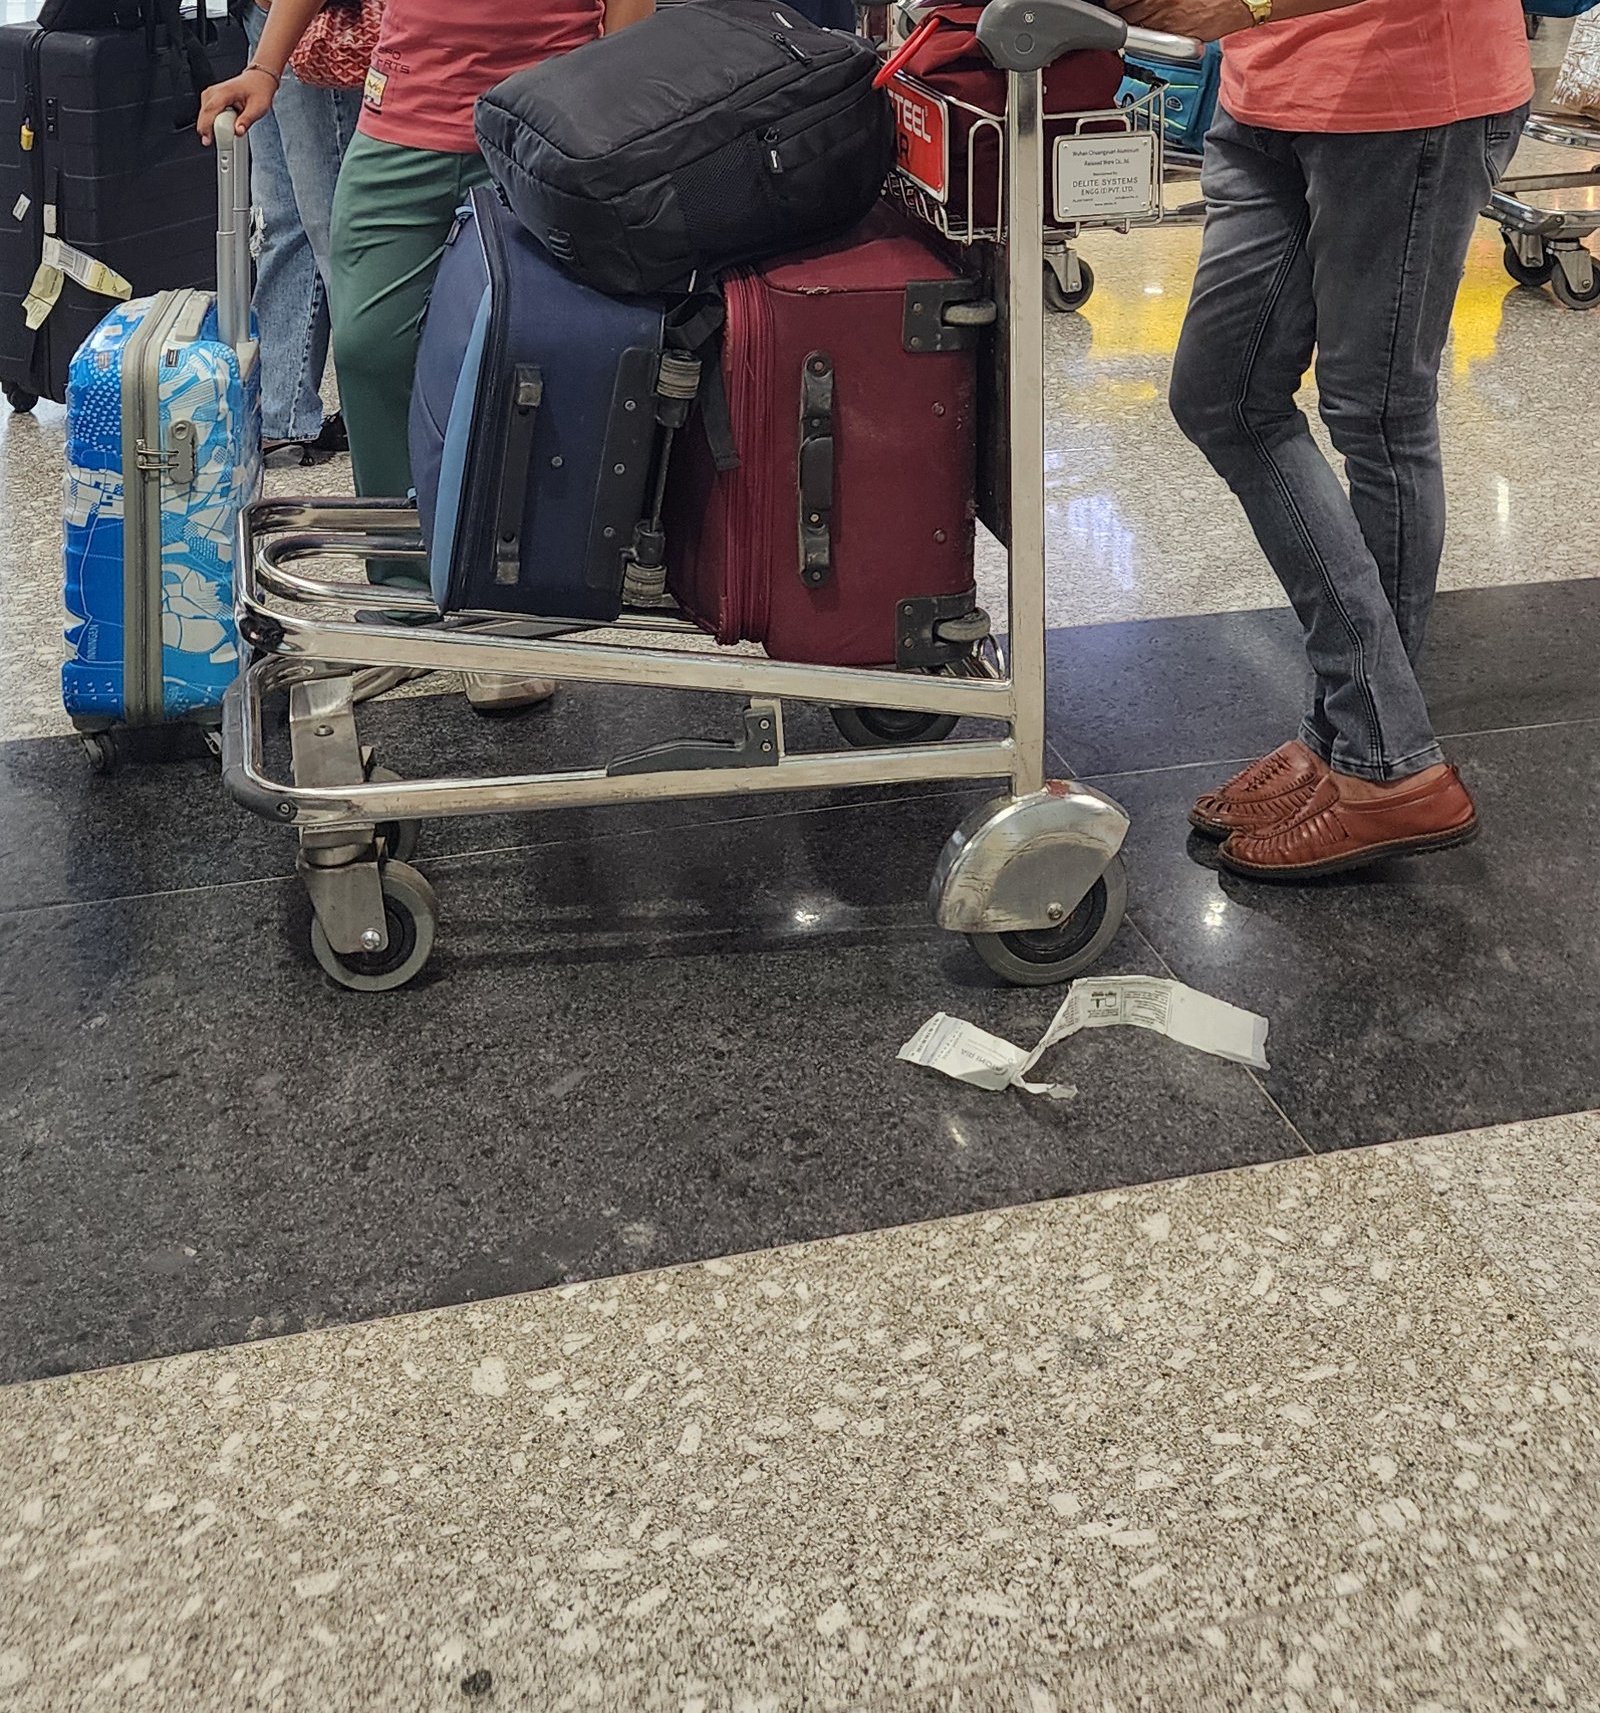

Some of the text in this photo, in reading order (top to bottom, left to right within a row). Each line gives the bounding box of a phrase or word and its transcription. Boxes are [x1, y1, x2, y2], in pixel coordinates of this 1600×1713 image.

[887, 88, 932, 144] TEEL
[1072, 176, 1138, 188] DELITE SYSTEMS
